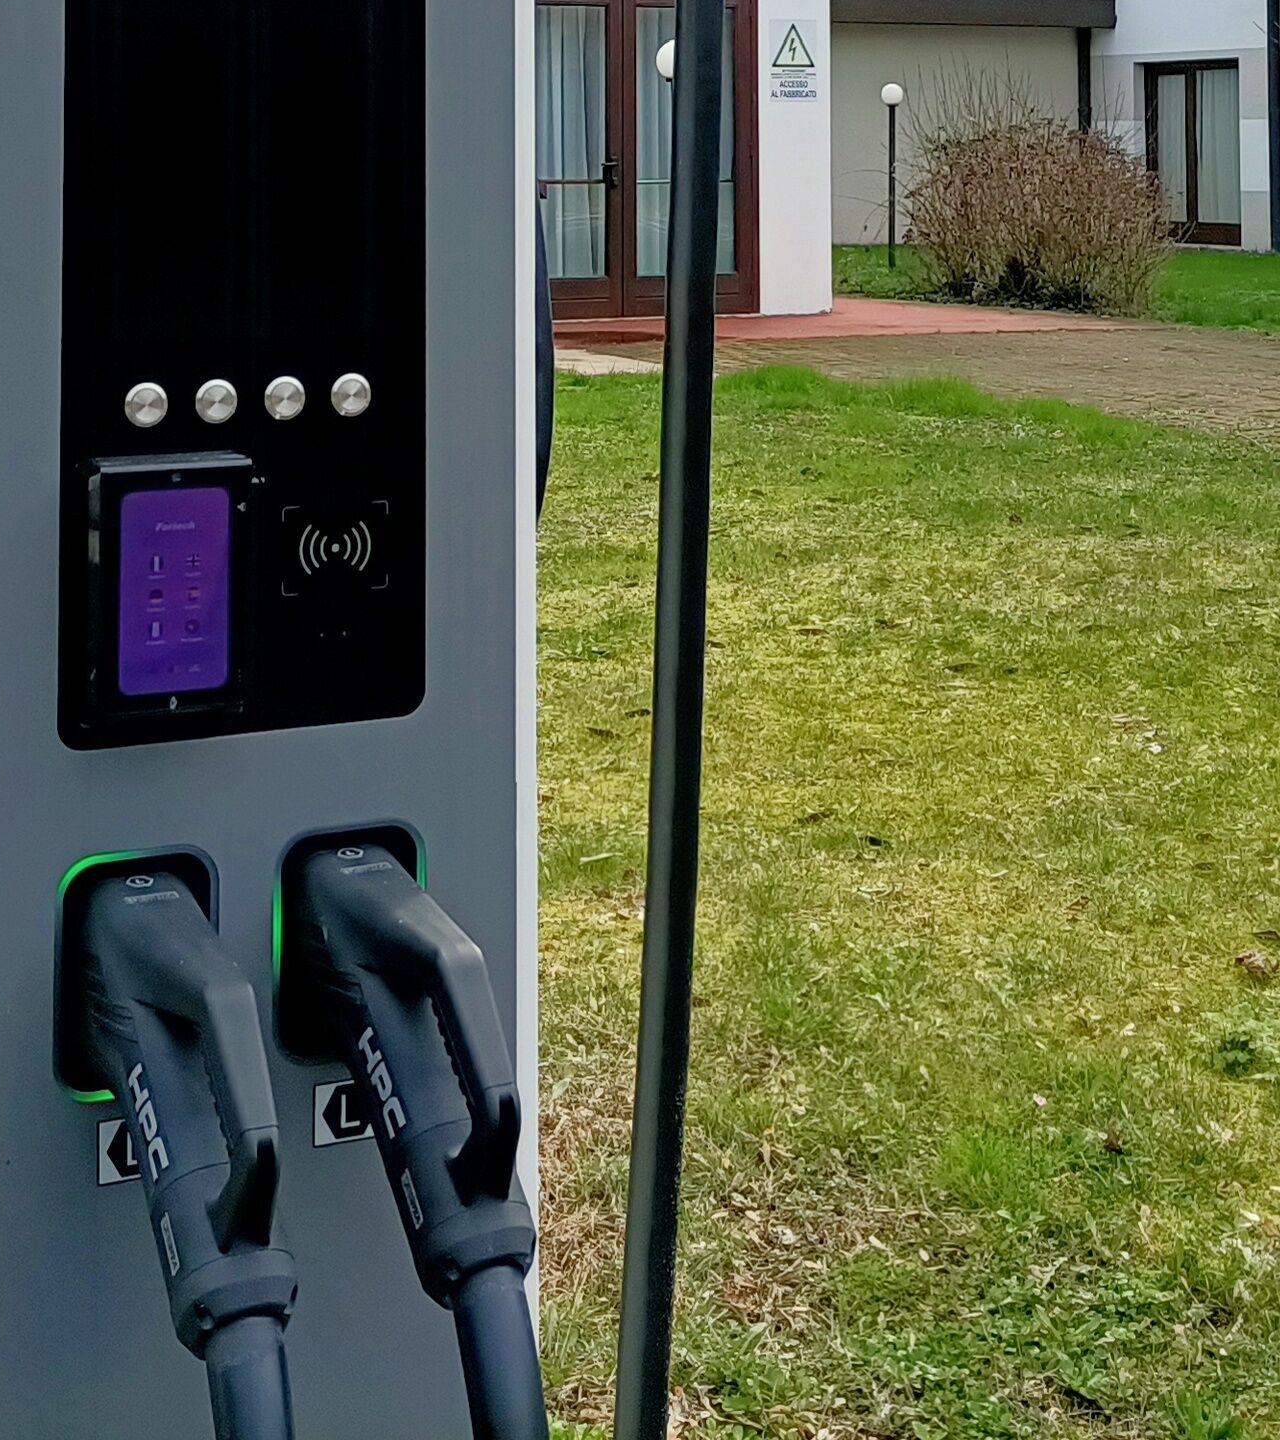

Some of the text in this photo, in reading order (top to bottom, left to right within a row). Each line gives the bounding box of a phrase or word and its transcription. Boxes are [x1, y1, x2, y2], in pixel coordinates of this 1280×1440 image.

[771, 90, 817, 98] AL FABBRICATO
[779, 80, 808, 88] ACCESSO
[358, 1026, 407, 1140] HPC
[127, 1062, 170, 1183] HPC
[340, 1093, 361, 1129] L
